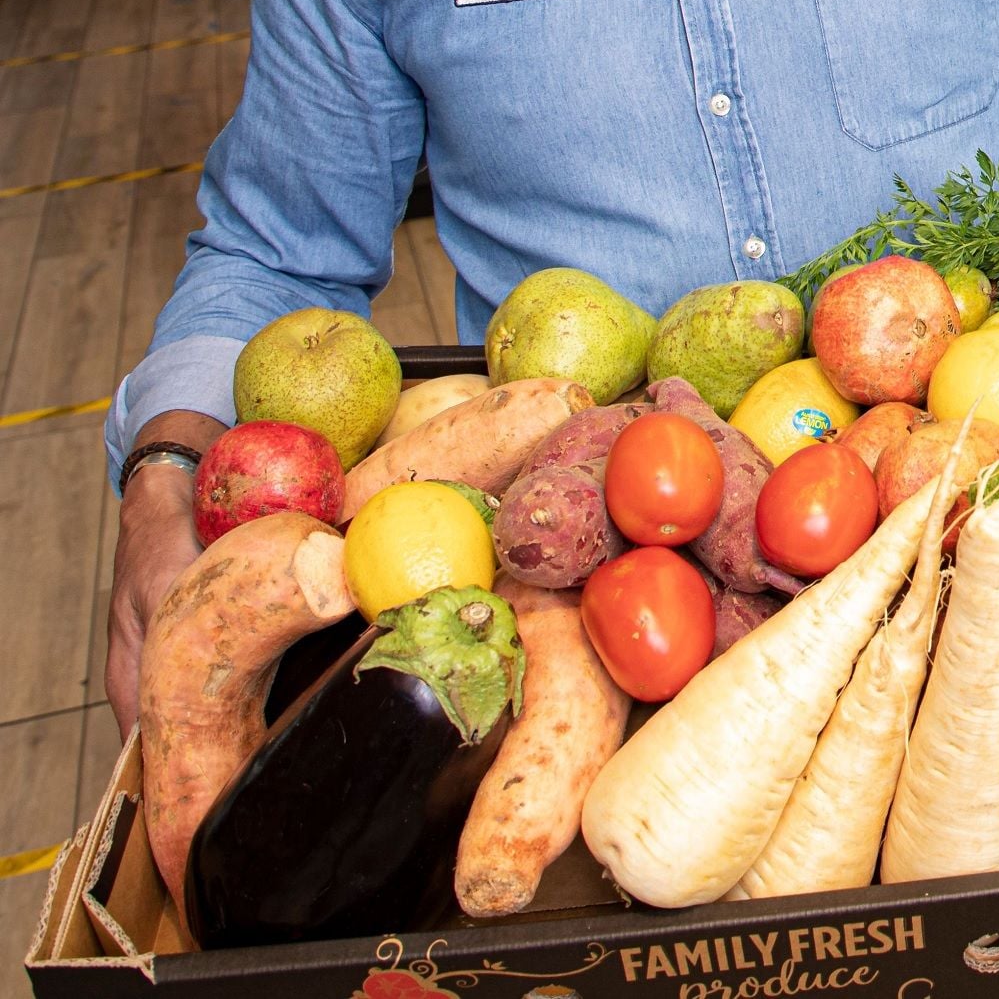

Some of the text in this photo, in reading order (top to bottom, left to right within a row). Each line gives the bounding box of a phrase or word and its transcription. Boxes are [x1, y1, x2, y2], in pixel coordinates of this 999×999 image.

[620, 914, 925, 983] FAMILY FRESH
[679, 958, 879, 999] produce
